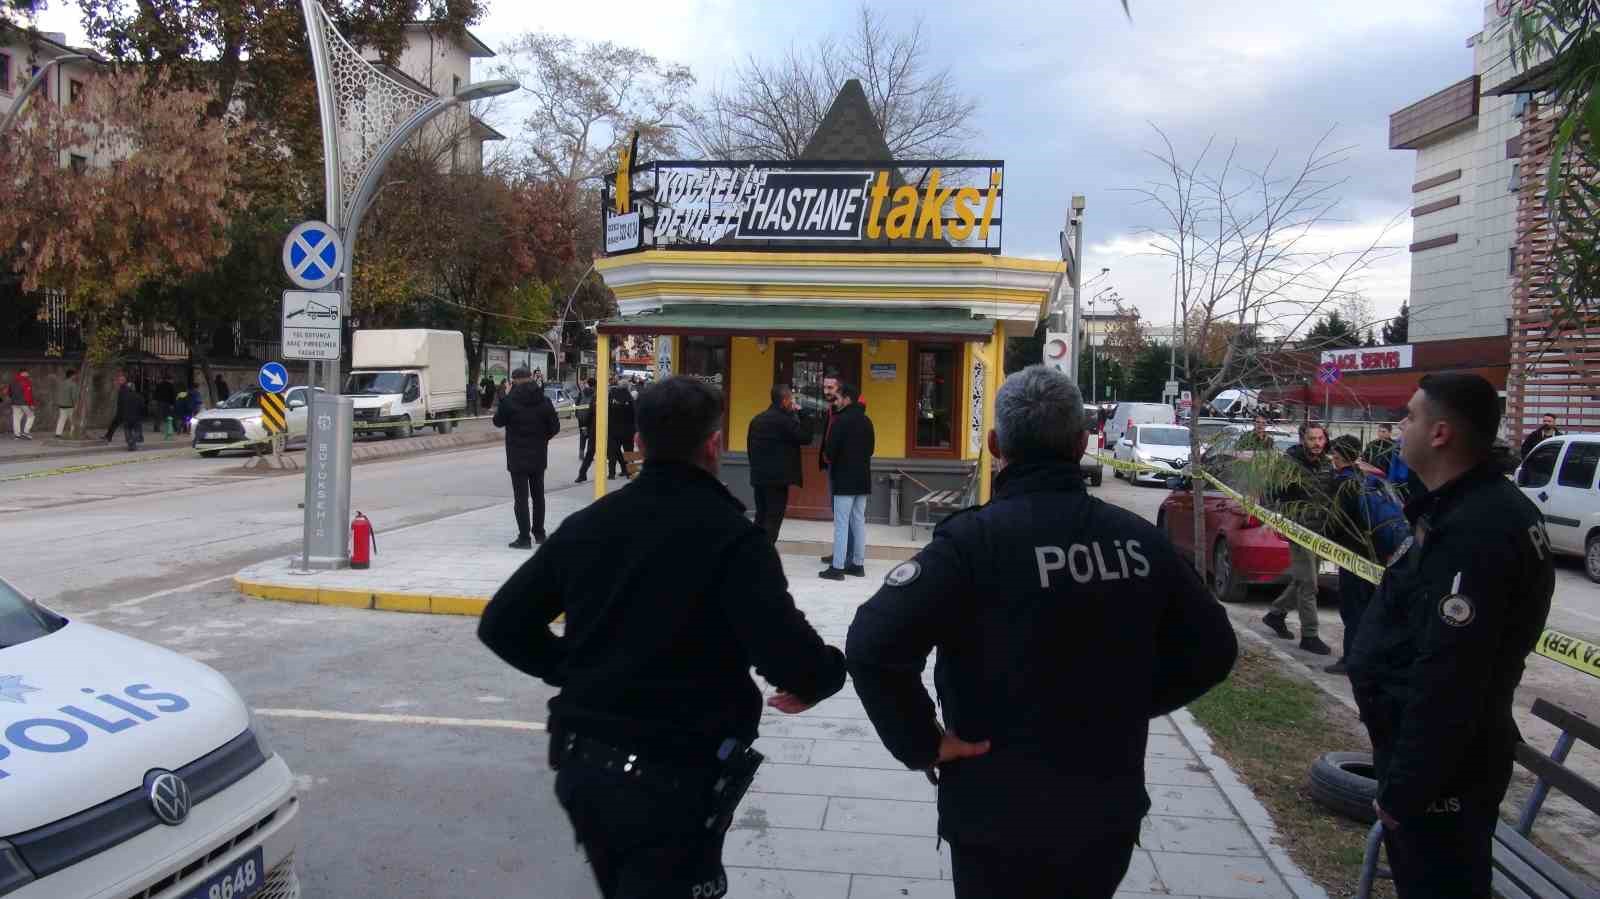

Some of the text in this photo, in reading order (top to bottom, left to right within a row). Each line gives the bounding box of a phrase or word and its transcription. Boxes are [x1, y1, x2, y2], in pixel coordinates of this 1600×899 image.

[747, 166, 1002, 242] HASTANE taksi
[0, 682, 190, 780] OLİS
